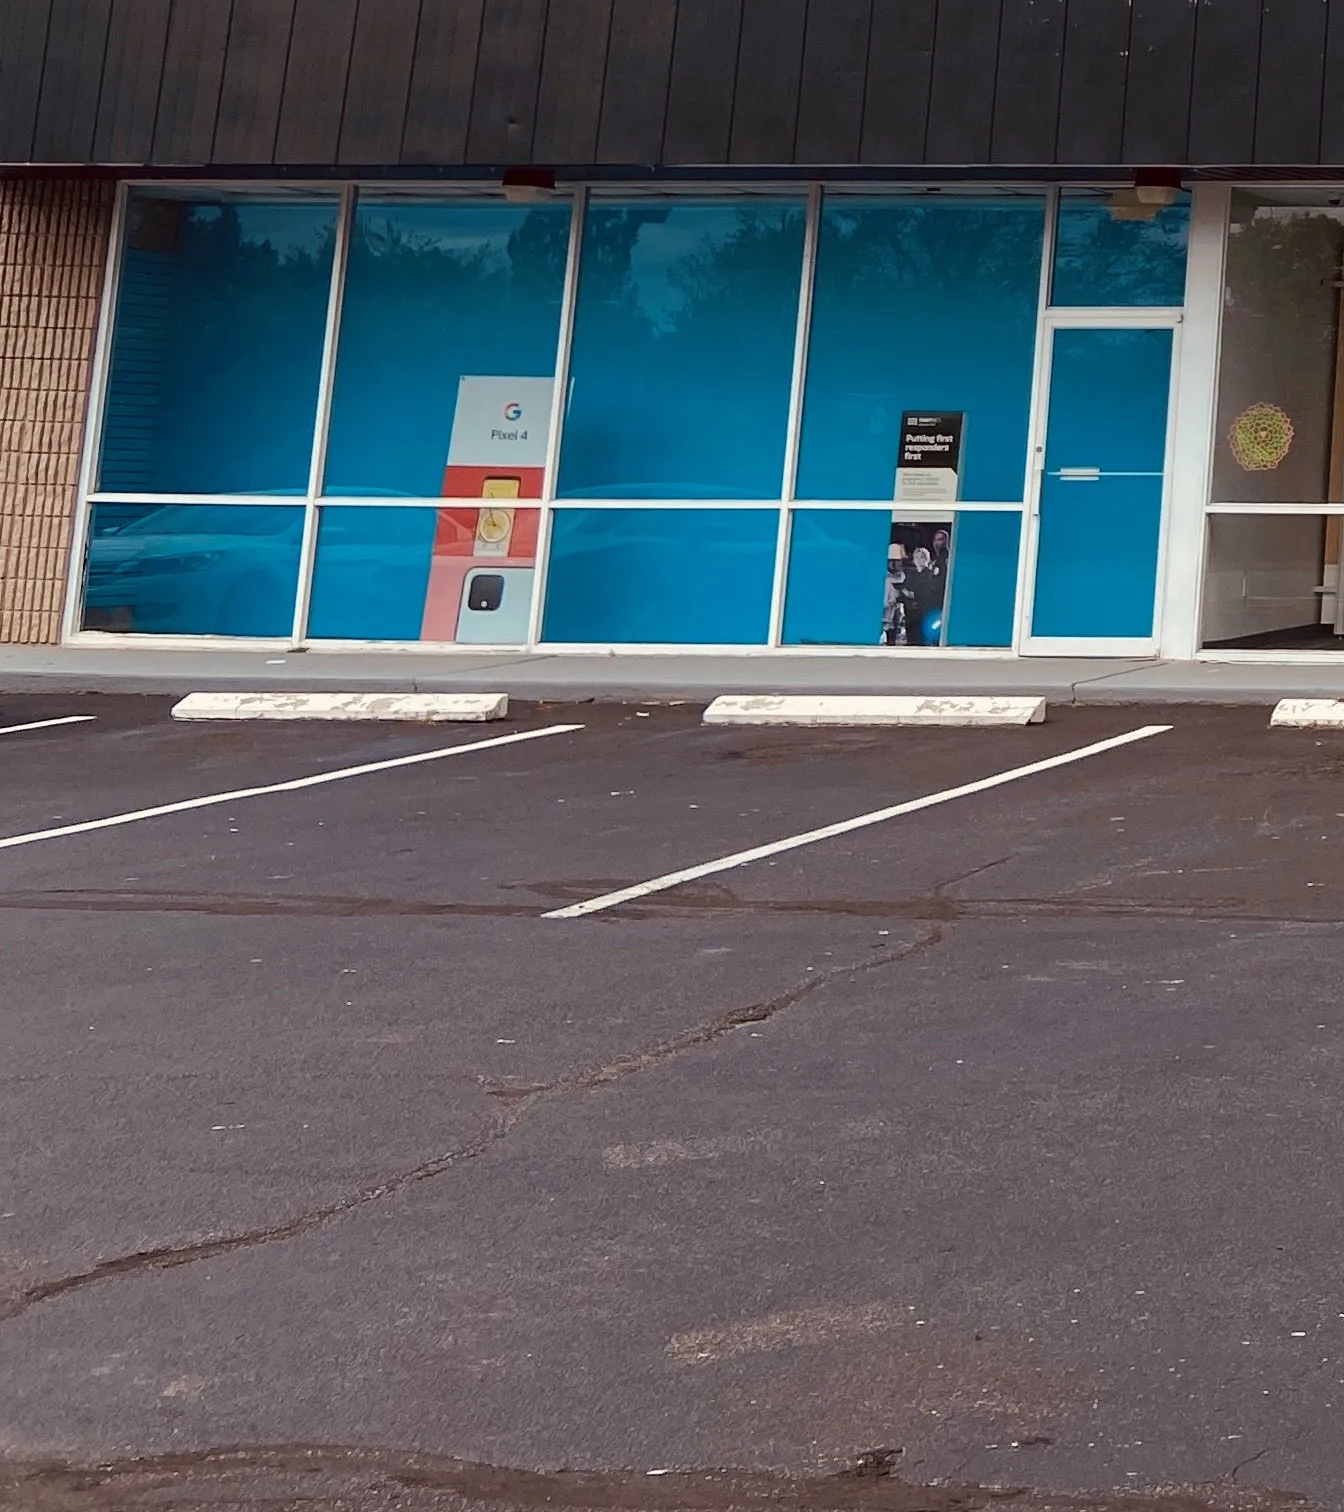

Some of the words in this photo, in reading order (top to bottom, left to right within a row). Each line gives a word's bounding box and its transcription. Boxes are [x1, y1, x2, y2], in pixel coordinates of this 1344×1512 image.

[490, 429, 518, 440] Pixel
[520, 430, 528, 440] 4
[905, 434, 936, 443] Putting
[936, 434, 954, 443] first
[904, 443, 950, 452] responders
[904, 452, 922, 460] first
